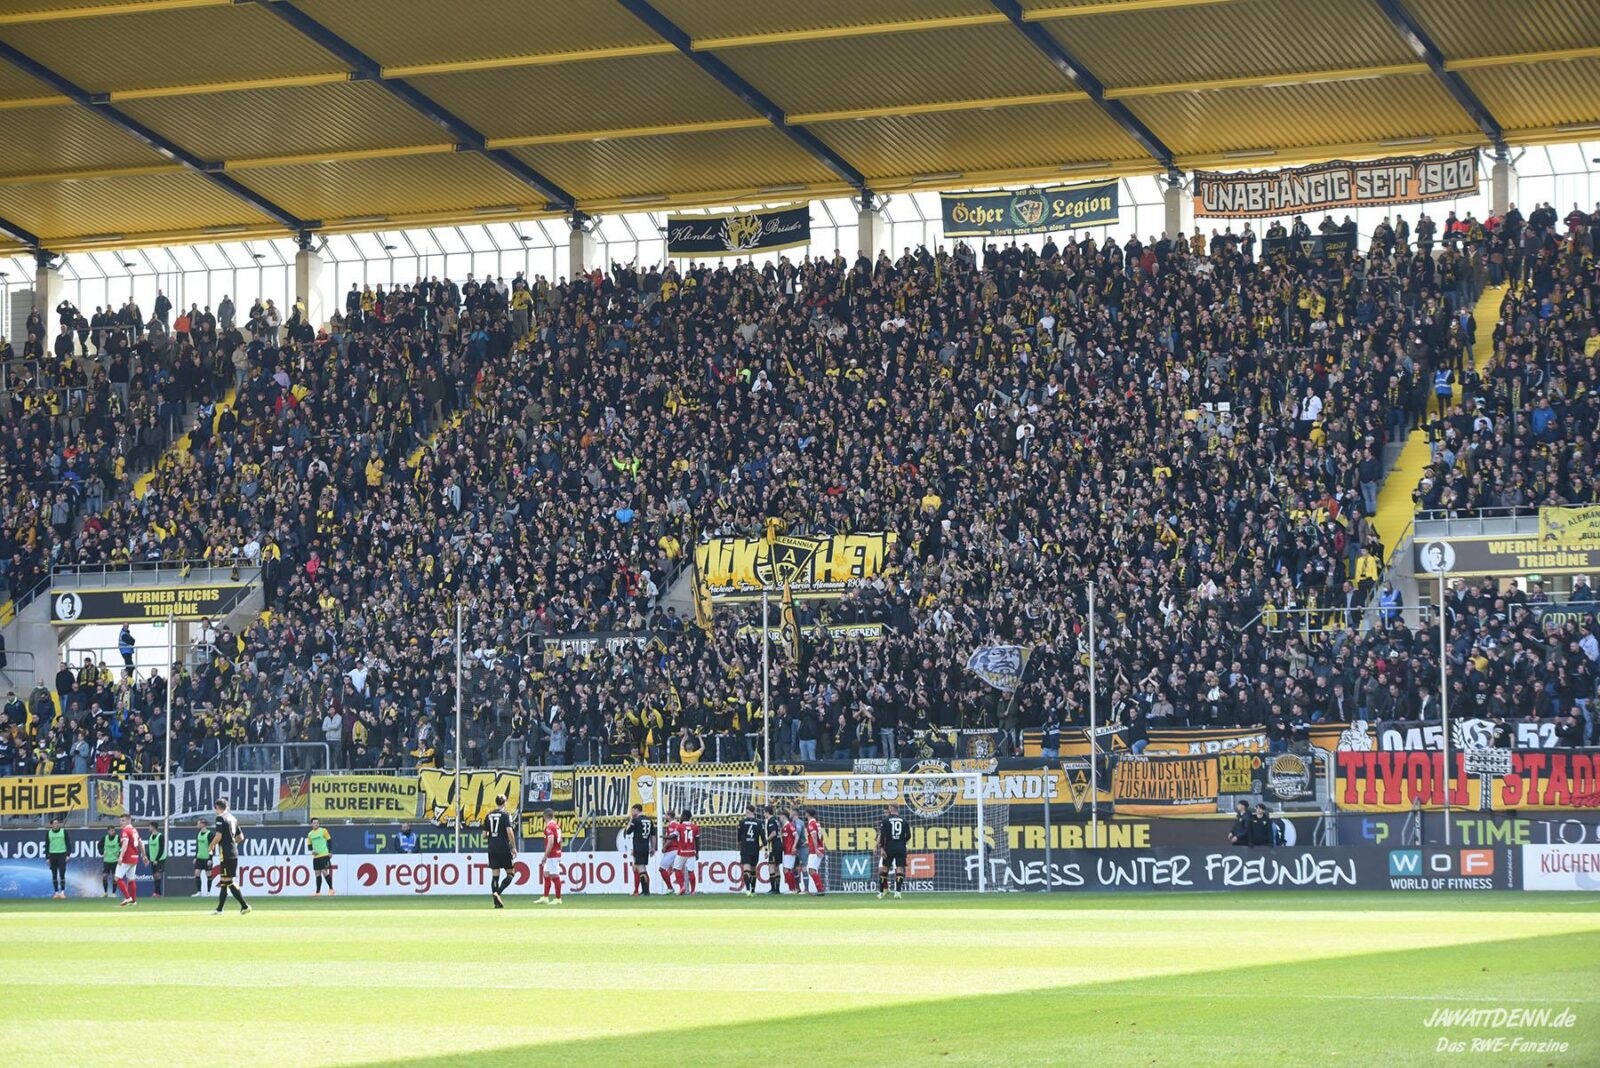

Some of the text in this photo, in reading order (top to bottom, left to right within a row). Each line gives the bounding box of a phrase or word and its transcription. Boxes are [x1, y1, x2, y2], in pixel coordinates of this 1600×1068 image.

[1202, 158, 1474, 211] UNABHÄNGIG SEIT 1900
[952, 195, 1111, 226] Öcher Legion
[782, 548, 796, 563] A
[1516, 552, 1589, 568] TRIBÜNE
[122, 589, 220, 604] WERNER FUCHS
[144, 601, 198, 616] TRIBÜNE
[1219, 755, 1252, 769] PYRO
[1121, 761, 1208, 780] FREUNDSCHAFT
[1338, 750, 1469, 805] TIVOLI
[312, 781, 416, 796] HÜRTGENWALD
[807, 775, 1058, 800] KARLS BANDE
[1119, 779, 1209, 799] ZUSAMMENHALT
[129, 776, 274, 817] BAD AACHEN
[324, 797, 404, 811] RUREIFEL
[575, 775, 631, 817] YELLOW
[489, 817, 500, 833] 17
[642, 822, 651, 836] 33
[747, 824, 754, 838] 4
[890, 820, 902, 835] 19
[1456, 819, 1530, 845] TIME
[684, 829, 693, 843] 14
[908, 827, 995, 849] UCHS
[1004, 821, 1150, 849] TRIBÜNE
[239, 857, 310, 894] regio
[386, 856, 459, 893] regio
[1097, 855, 1193, 886] UNTER
[1204, 853, 1357, 886] FREUNDEN
[843, 881, 877, 891] WORLD
[1390, 878, 1493, 889] WORLD OF FITNESS
